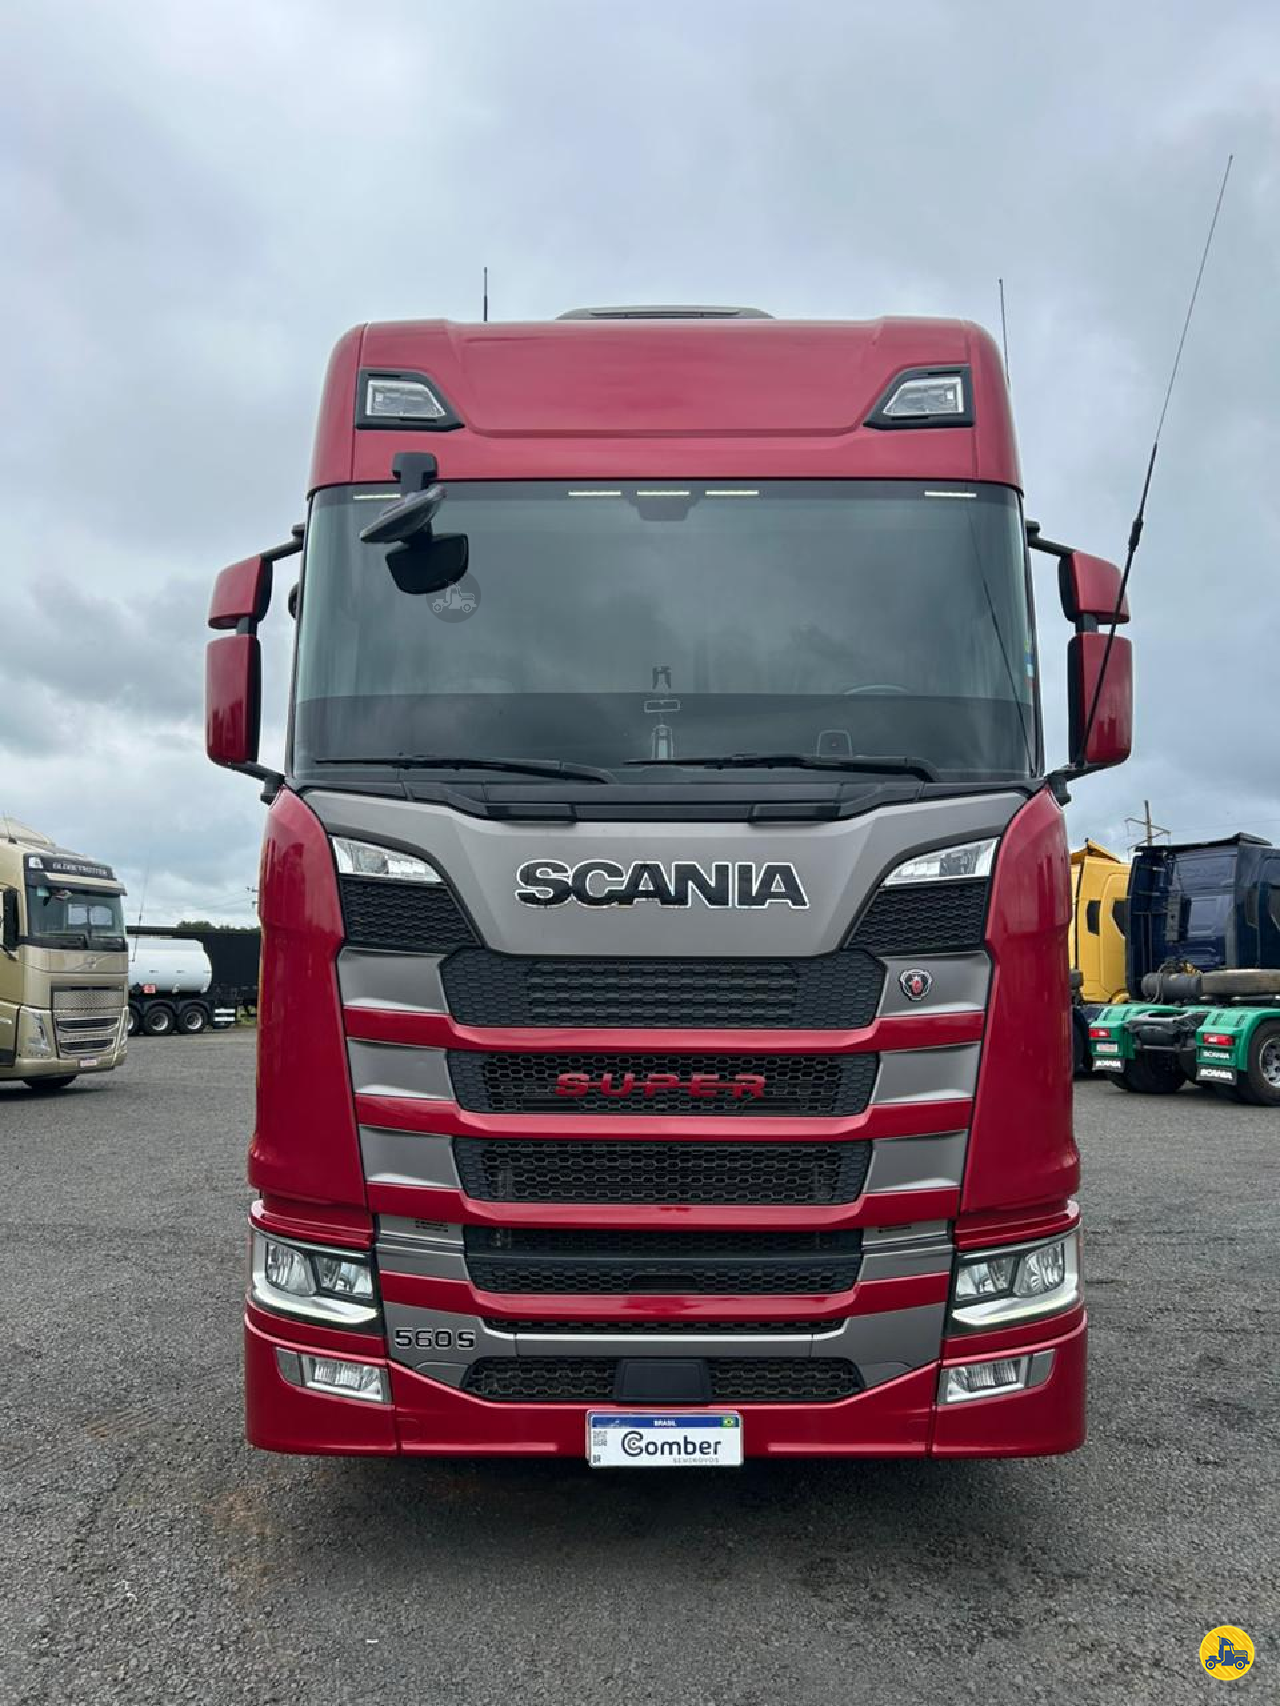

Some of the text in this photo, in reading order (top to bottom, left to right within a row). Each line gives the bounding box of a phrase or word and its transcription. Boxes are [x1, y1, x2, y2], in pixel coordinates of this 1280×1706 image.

[515, 859, 809, 909] SCANIA
[555, 1073, 765, 1098] SUPER
[654, 1419, 677, 1427] BRASIL
[621, 1430, 721, 1458] Comber
